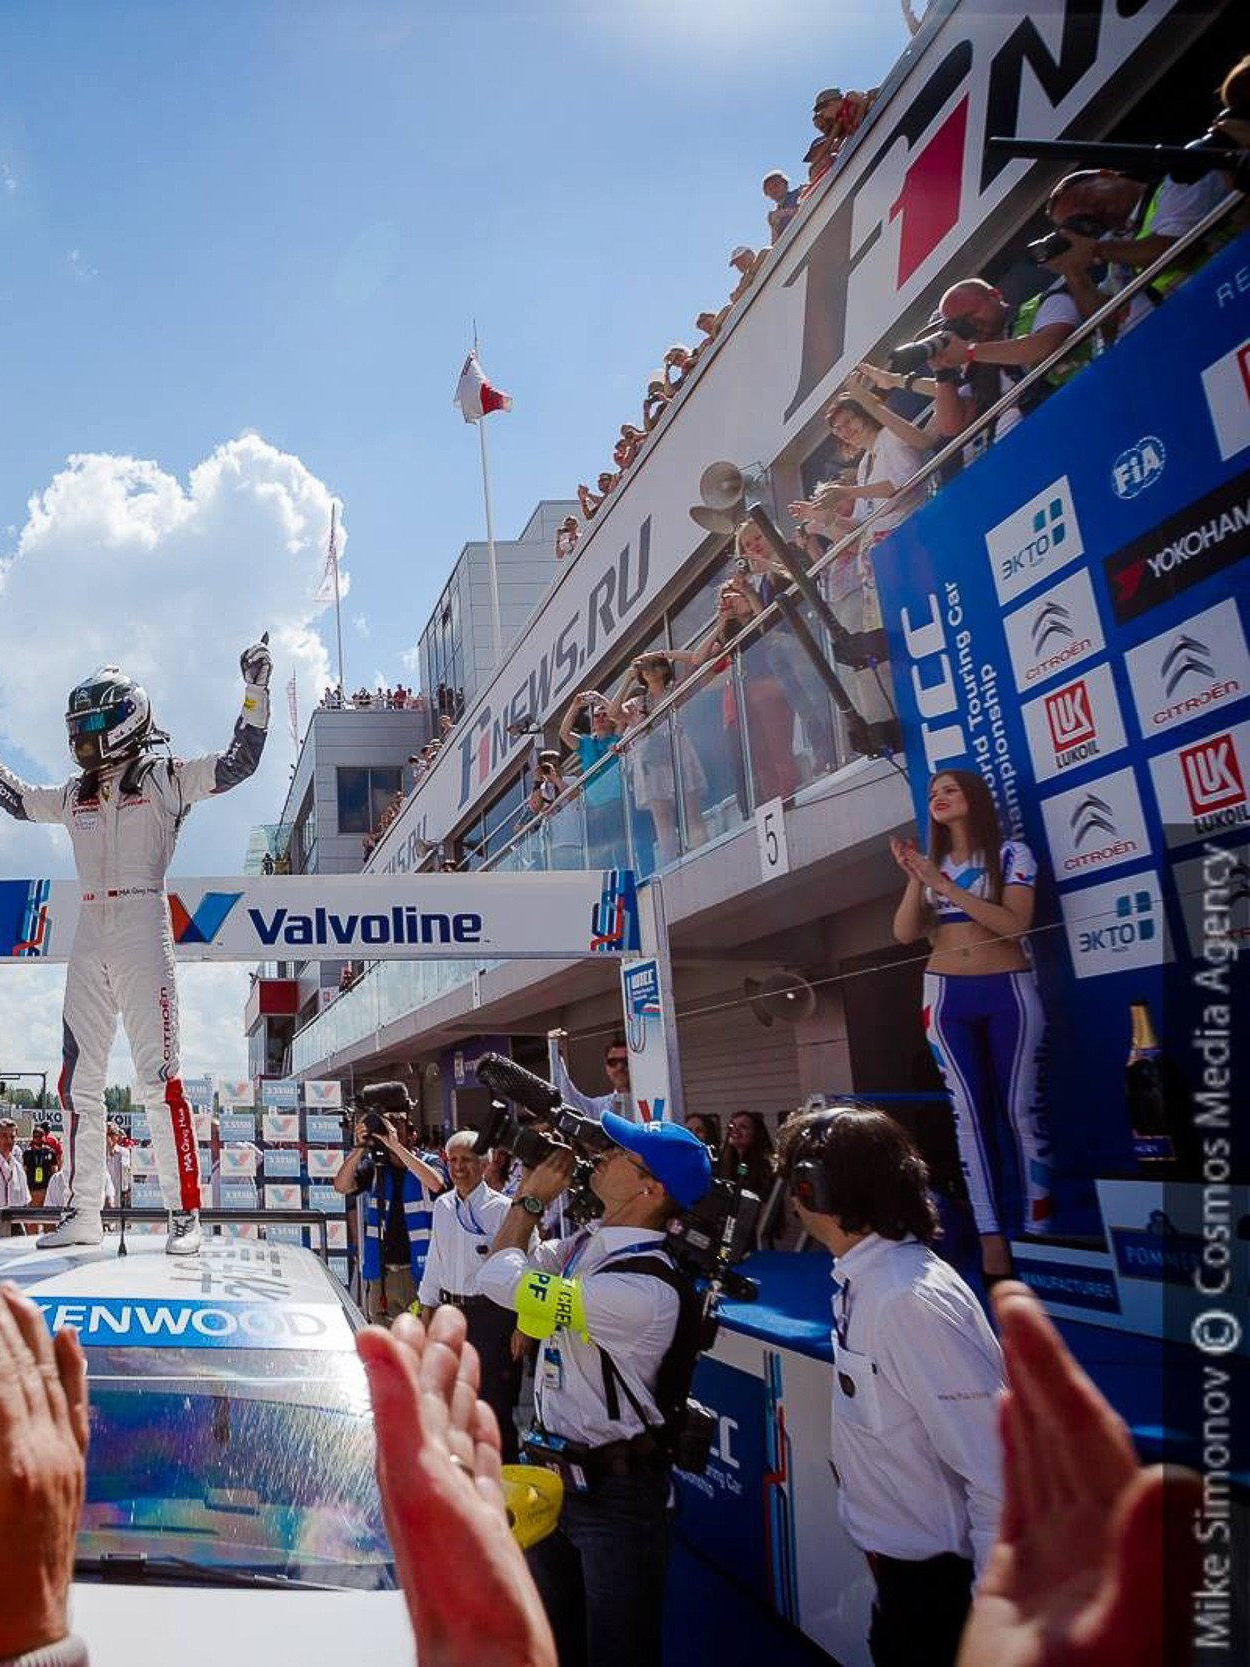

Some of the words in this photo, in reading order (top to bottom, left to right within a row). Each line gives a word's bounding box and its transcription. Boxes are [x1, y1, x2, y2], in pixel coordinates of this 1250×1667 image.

[945, 581, 963, 627] Car
[901, 594, 967, 774] TCC
[956, 630, 984, 731] Touring
[973, 735, 1001, 808] orld
[980, 663, 1026, 842] hampionship
[1056, 741, 1100, 769] LUKOIL
[764, 813, 779, 866] 5
[1193, 804, 1250, 835] LUKOIL
[248, 907, 482, 945] Valvoline
